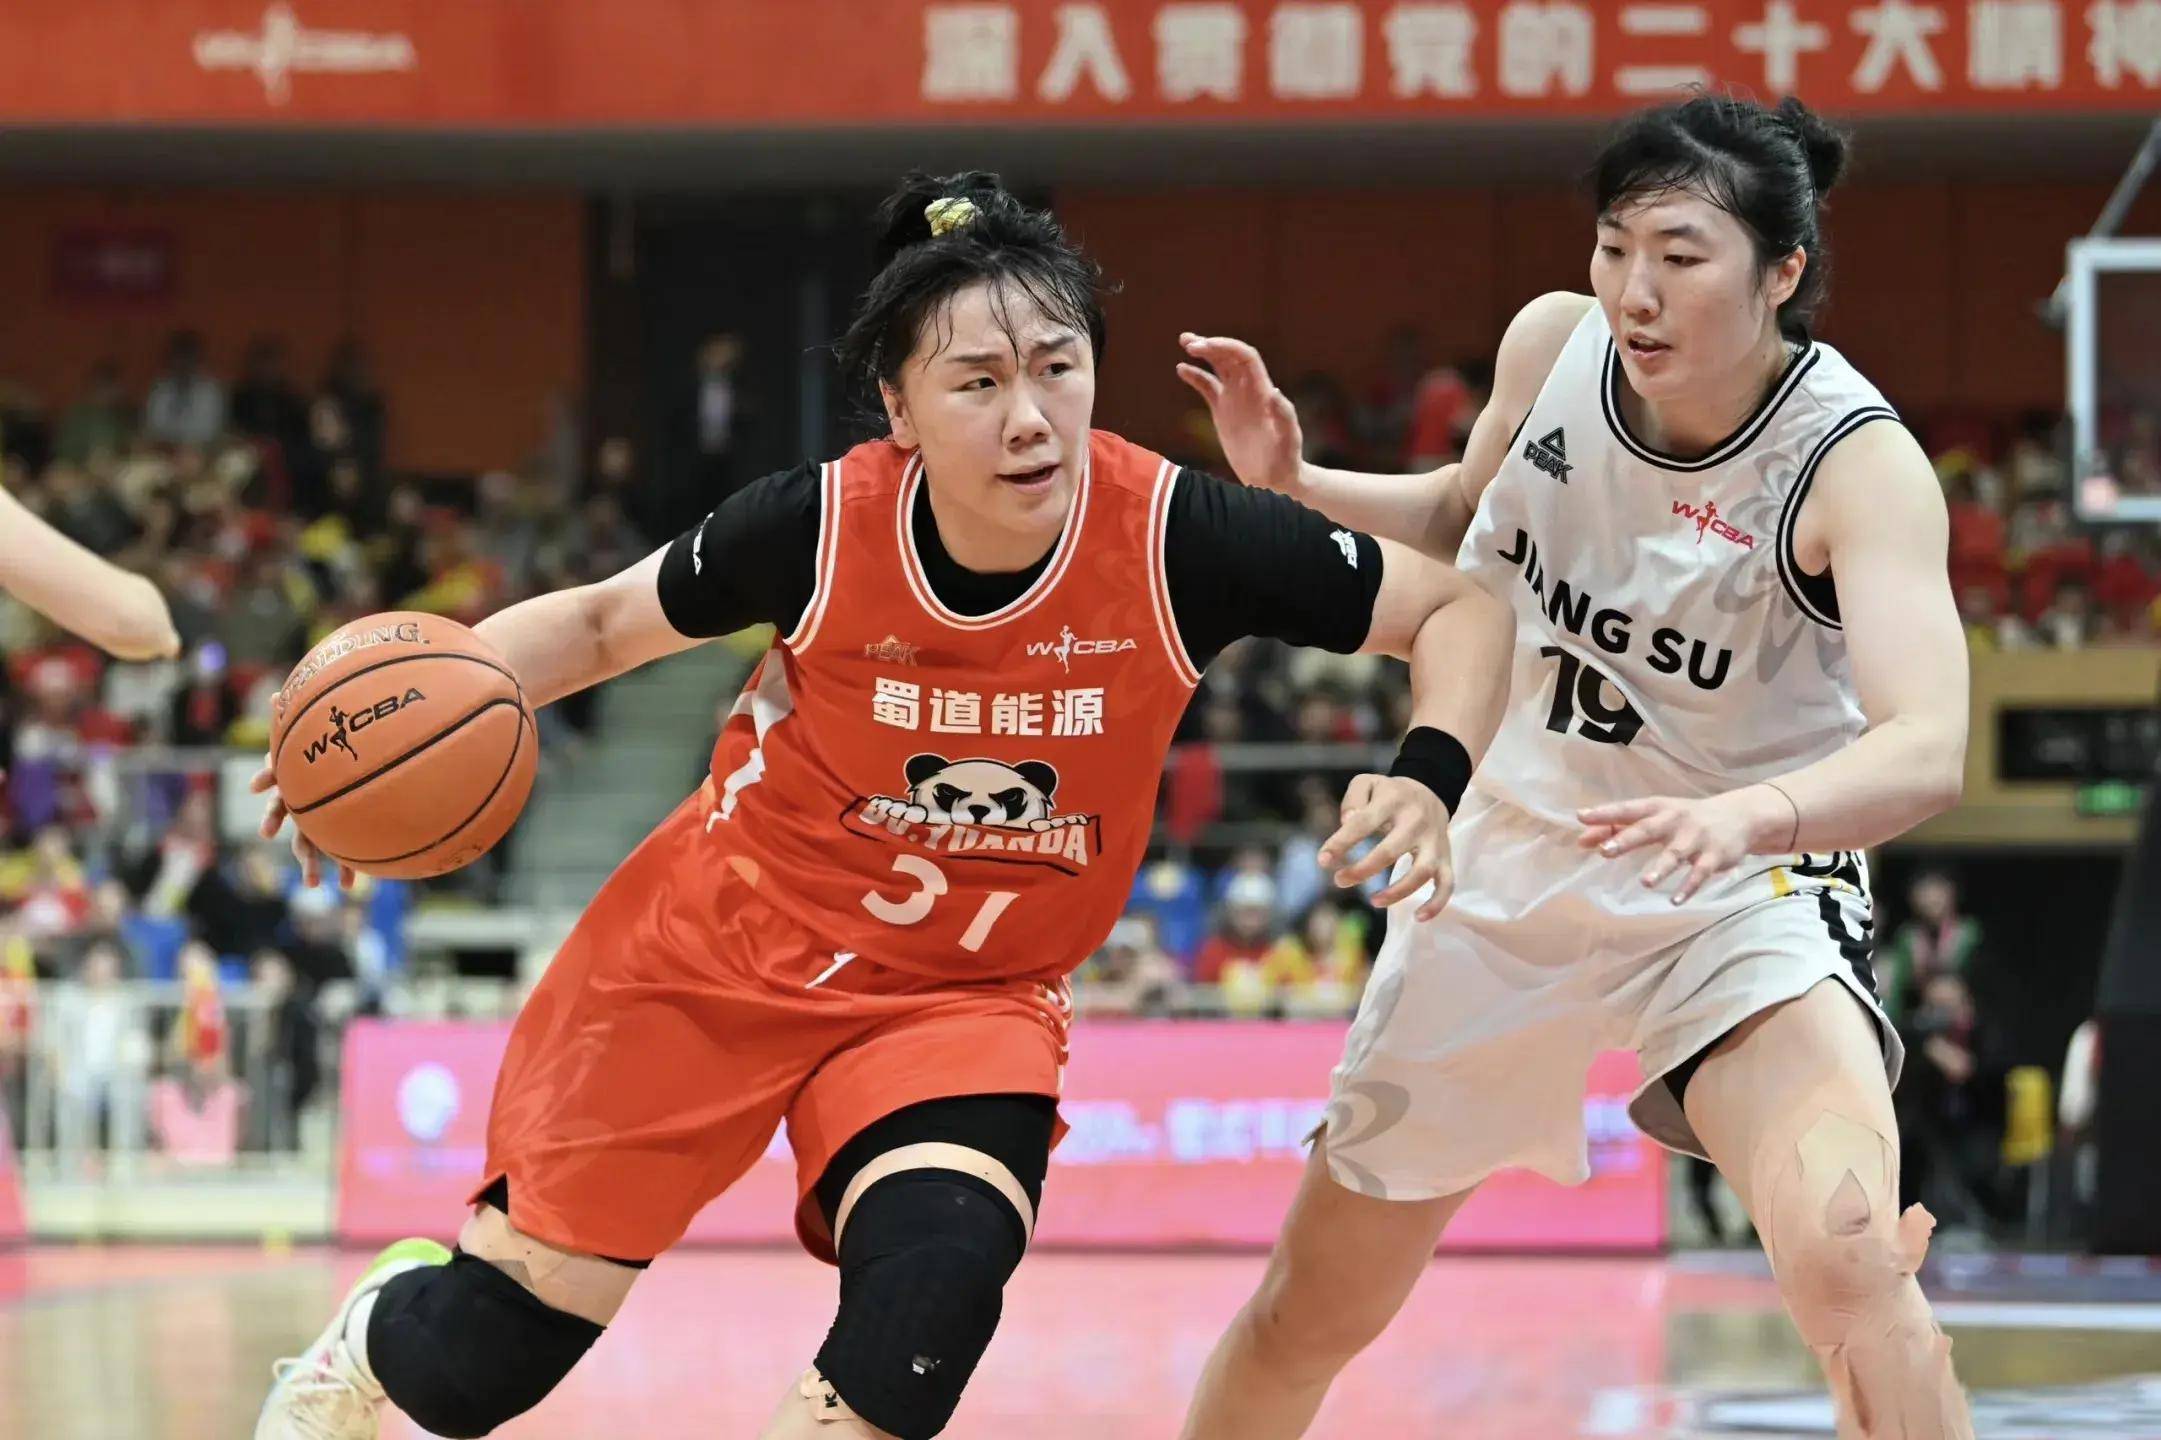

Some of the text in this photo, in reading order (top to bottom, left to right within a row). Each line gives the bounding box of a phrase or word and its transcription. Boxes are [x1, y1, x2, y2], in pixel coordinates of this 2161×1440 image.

[1523, 440, 1573, 484] PEAK
[1672, 500, 1754, 549] WCBA
[1645, 628, 1732, 690] SU
[303, 688, 426, 764] WCBA
[871, 677, 1104, 737] 蜀道能源
[1540, 646, 1644, 745] 19
[861, 854, 1020, 952] 31
